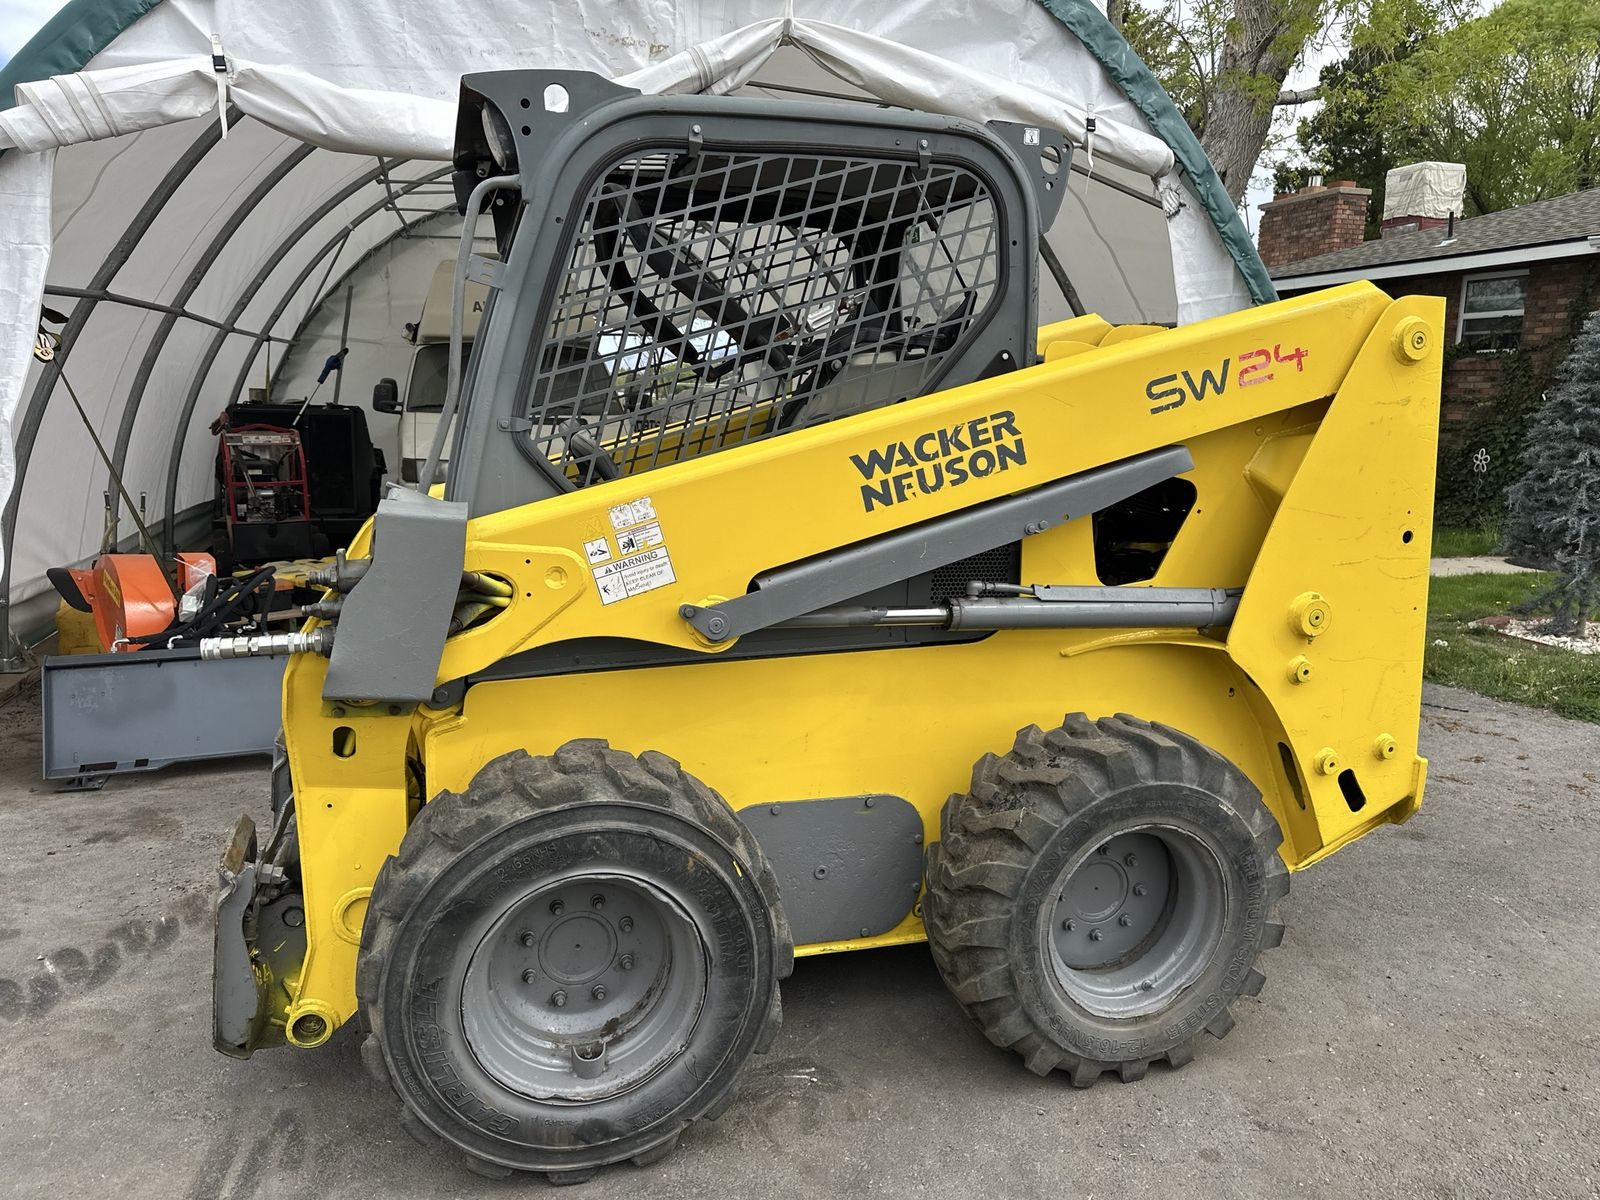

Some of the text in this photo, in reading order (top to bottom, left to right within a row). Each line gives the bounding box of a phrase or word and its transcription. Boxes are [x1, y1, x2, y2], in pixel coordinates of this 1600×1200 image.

[849, 410, 1021, 480] WACKER
[613, 551, 658, 571] WARNING
[640, 572, 656, 581] CLEAR
[1240, 847, 1261, 942] PREMIUM
[1220, 947, 1250, 992] SKID
[1165, 993, 1219, 1040] STEER
[415, 973, 521, 1136] CARLISLE
